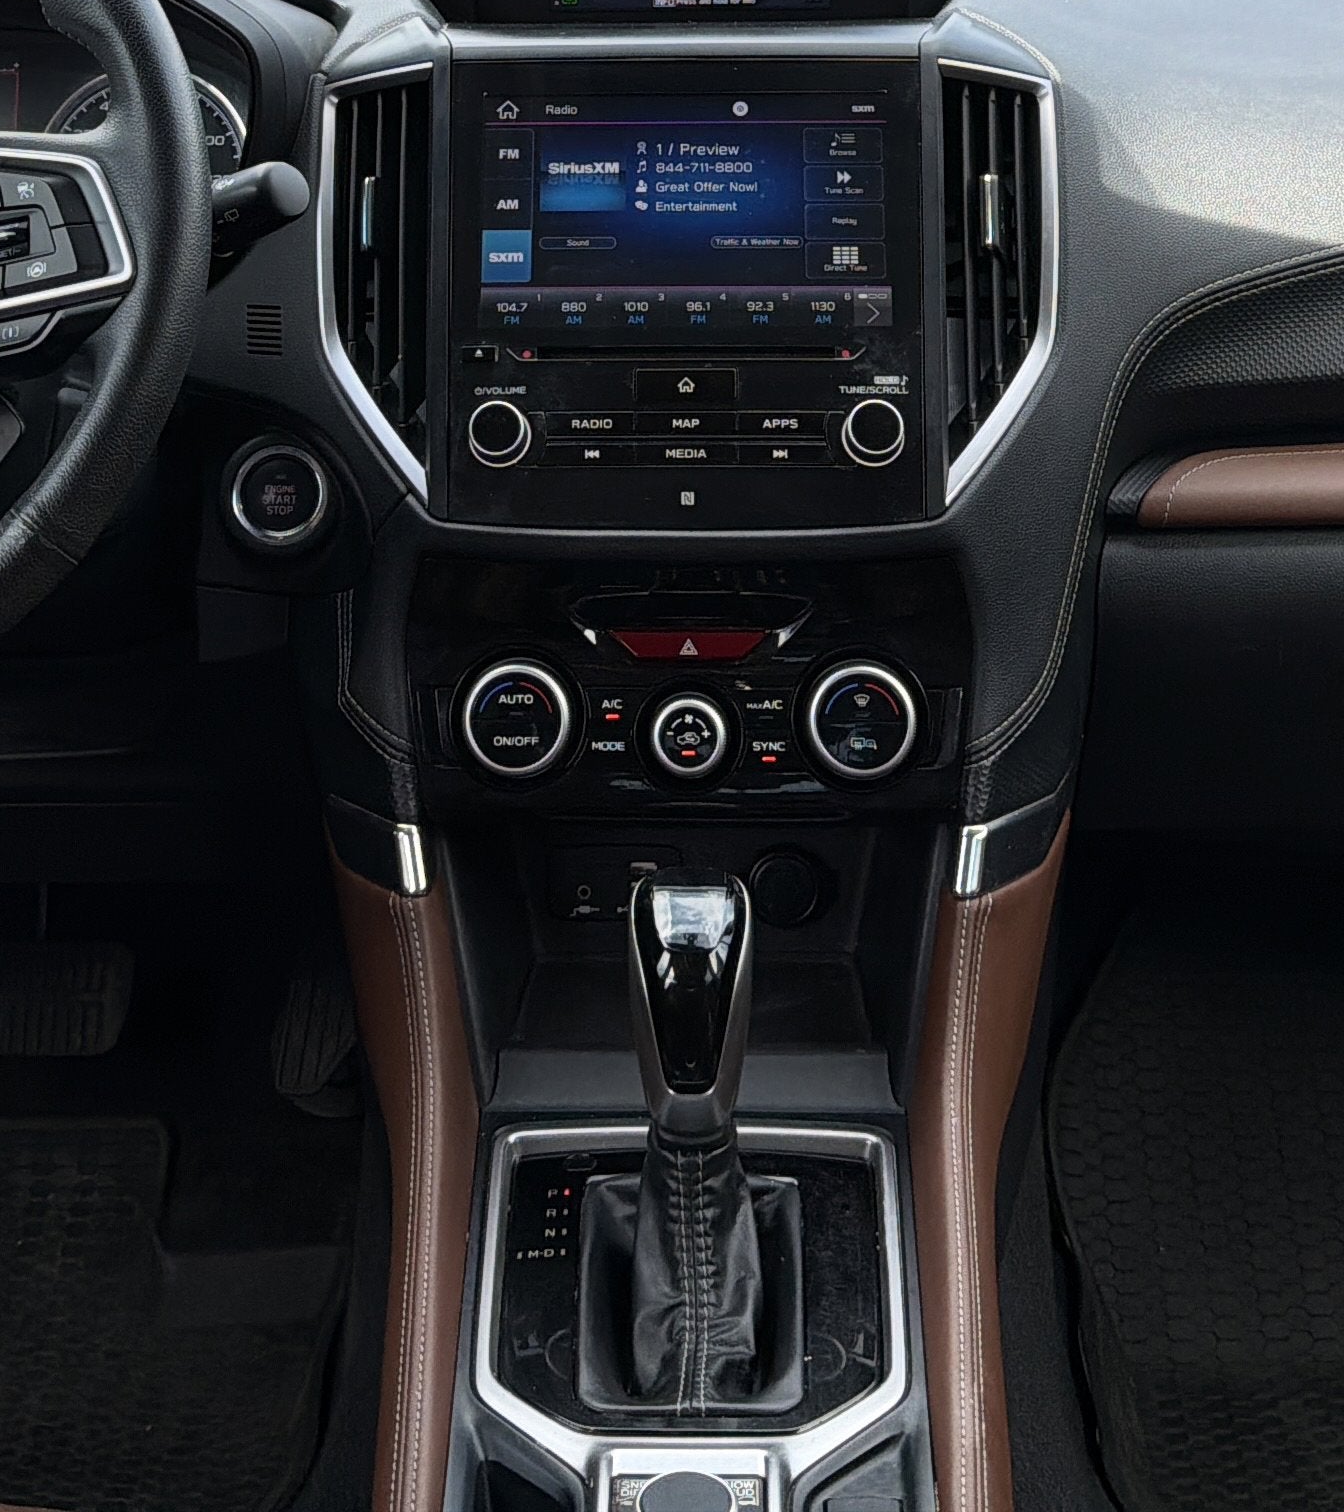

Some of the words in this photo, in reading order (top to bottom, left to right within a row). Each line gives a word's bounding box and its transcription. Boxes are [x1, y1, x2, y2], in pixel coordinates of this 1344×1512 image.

[545, 103, 578, 116] Radio
[498, 148, 520, 160] FM
[655, 143, 663, 156] 1
[679, 142, 740, 157] Preview
[548, 160, 620, 175] SiriusXM
[655, 161, 753, 174] 844-711-8800
[655, 180, 689, 194] Great
[693, 180, 725, 194] Offer
[729, 180, 758, 194] Now!
[824, 186, 842, 195] Tune
[844, 186, 864, 195] Scan
[496, 198, 519, 211] AM
[655, 200, 738, 213] Entertainment
[566, 238, 590, 247] Sound
[750, 238, 780, 247] Weather
[782, 238, 799, 247] Now
[488, 250, 524, 264] sxm
[495, 301, 528, 313] 104.7
[561, 301, 587, 313] 880
[623, 301, 649, 313] 1010
[685, 301, 711, 313] 96.1
[746, 301, 774, 313] 92.3
[811, 301, 836, 313] 1130
[503, 315, 520, 326] FM
[565, 315, 582, 326] AM
[627, 315, 644, 326] AM
[690, 315, 706, 326] FM
[752, 315, 769, 326] FM
[814, 315, 832, 326] AM
[839, 385, 909, 396] TUNE/SCROLL
[571, 418, 613, 430] RADIO
[672, 417, 700, 430] MAP
[762, 418, 799, 430] APPS
[665, 448, 707, 460] MEDIA
[264, 484, 296, 494] ENGINE
[262, 494, 297, 505] START
[266, 505, 294, 516] STOP
[497, 693, 534, 706] AUTO
[602, 698, 623, 711] A/C
[492, 735, 539, 748] ON/OFF
[591, 740, 625, 752] MODE
[752, 740, 786, 753] SYNC
[547, 1188, 559, 1199] P
[546, 1207, 557, 1218] R
[545, 1228, 555, 1238] N
[735, 1488, 755, 1497] UD
